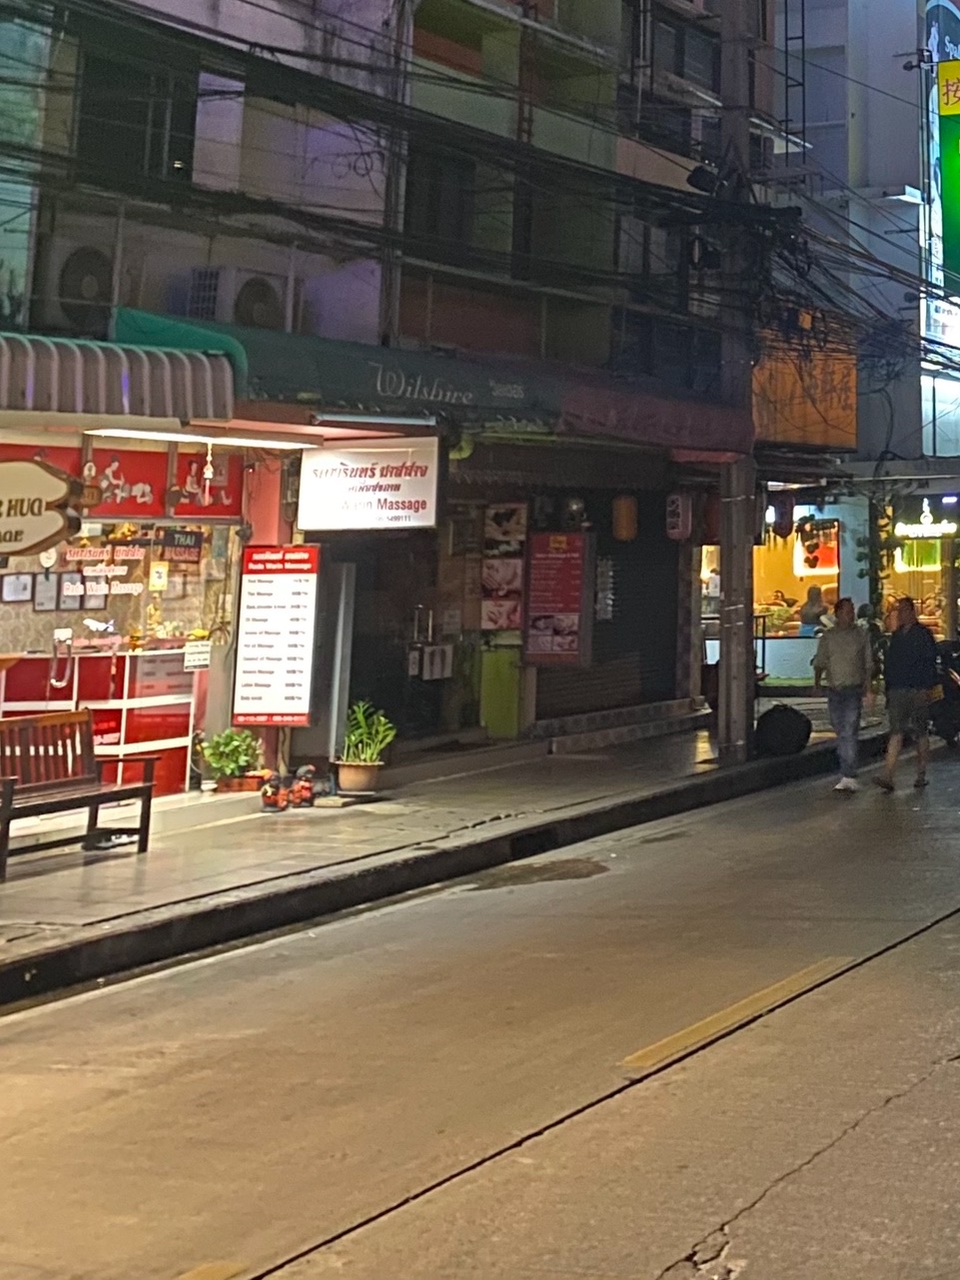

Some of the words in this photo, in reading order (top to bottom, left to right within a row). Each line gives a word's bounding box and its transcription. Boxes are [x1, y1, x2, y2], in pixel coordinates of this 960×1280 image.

[367, 361, 474, 405] Wilshire
[377, 498, 427, 513] Massage
[173, 534, 196, 546] THAI
